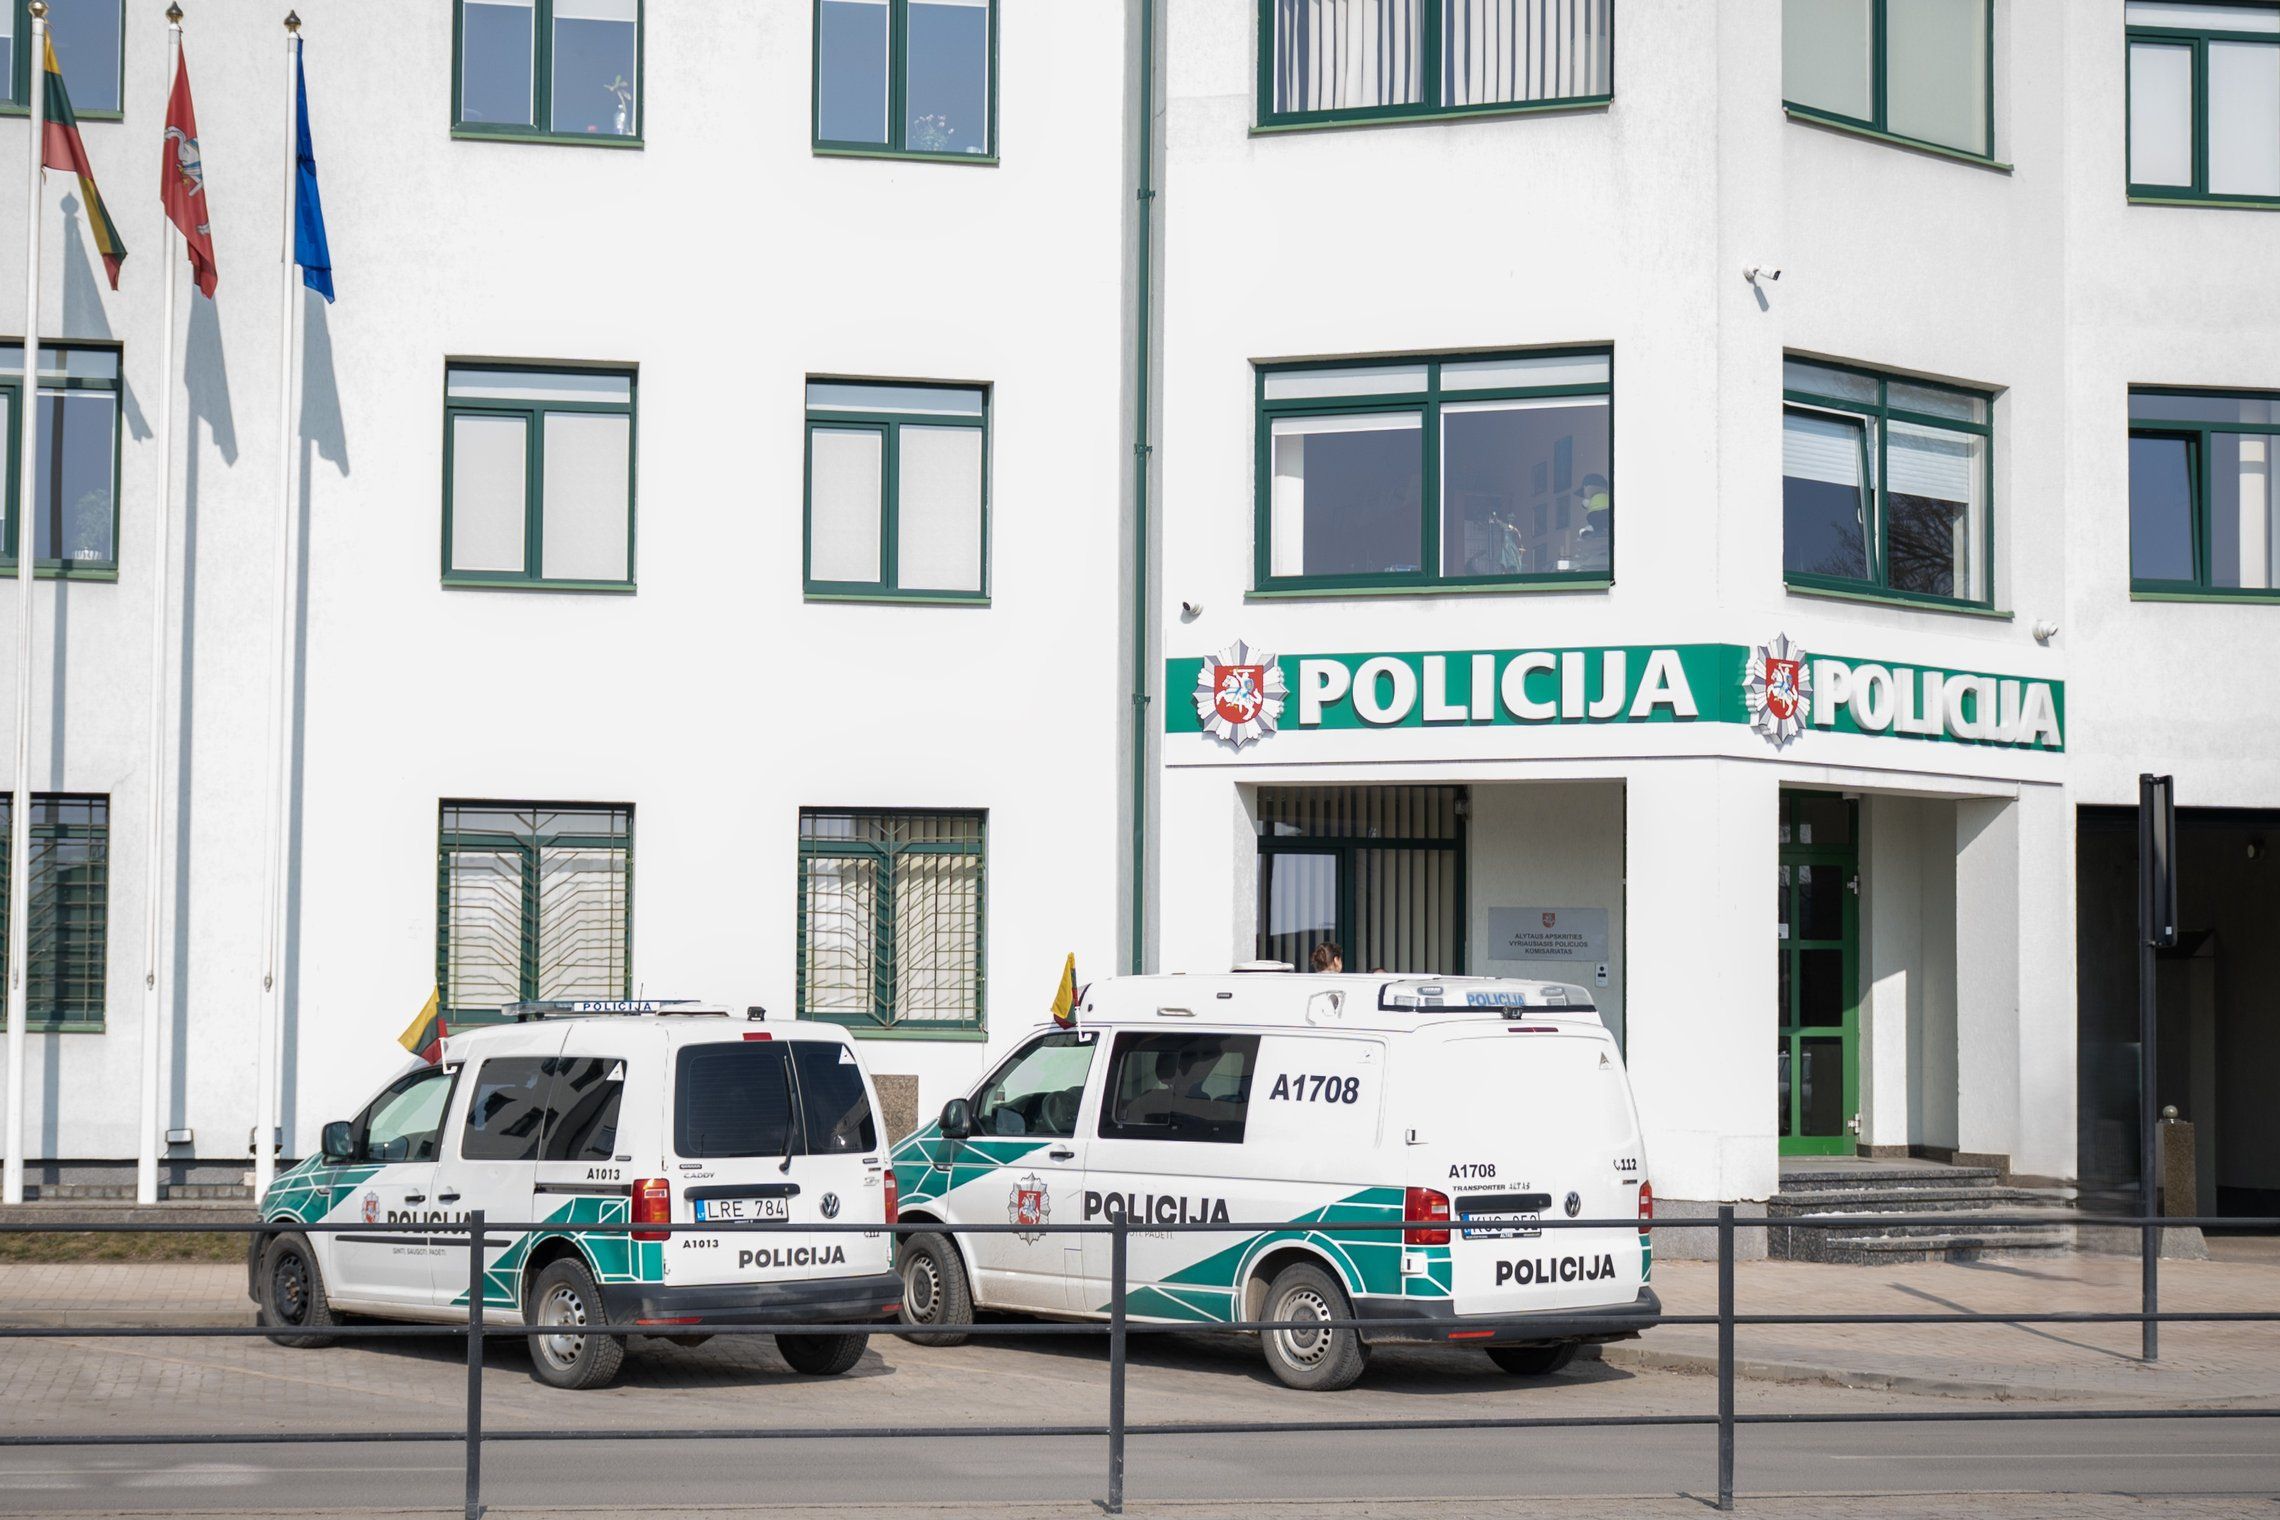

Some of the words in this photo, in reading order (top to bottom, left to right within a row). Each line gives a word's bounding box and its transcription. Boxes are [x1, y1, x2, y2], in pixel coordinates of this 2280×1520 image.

[1299, 649, 1700, 725] POLICIJA
[1813, 658, 2063, 746] POLICIJA
[583, 1002, 652, 1011] POLICIJA
[1466, 993, 1526, 1007] POLICIJA
[1268, 1073, 1360, 1105] A1708
[1448, 1163, 1496, 1179] A1708
[1620, 1158, 1637, 1171] 112
[586, 1168, 620, 1180] A1013
[1452, 1184, 1506, 1192] TRANSPORTER
[707, 1201, 744, 1218] LRE
[755, 1200, 784, 1217] 784
[1084, 1190, 1230, 1224] POLICIJA
[683, 1239, 719, 1249] A1013
[738, 1245, 846, 1269] POLICIJA
[1496, 1253, 1616, 1287] POLICIJA
